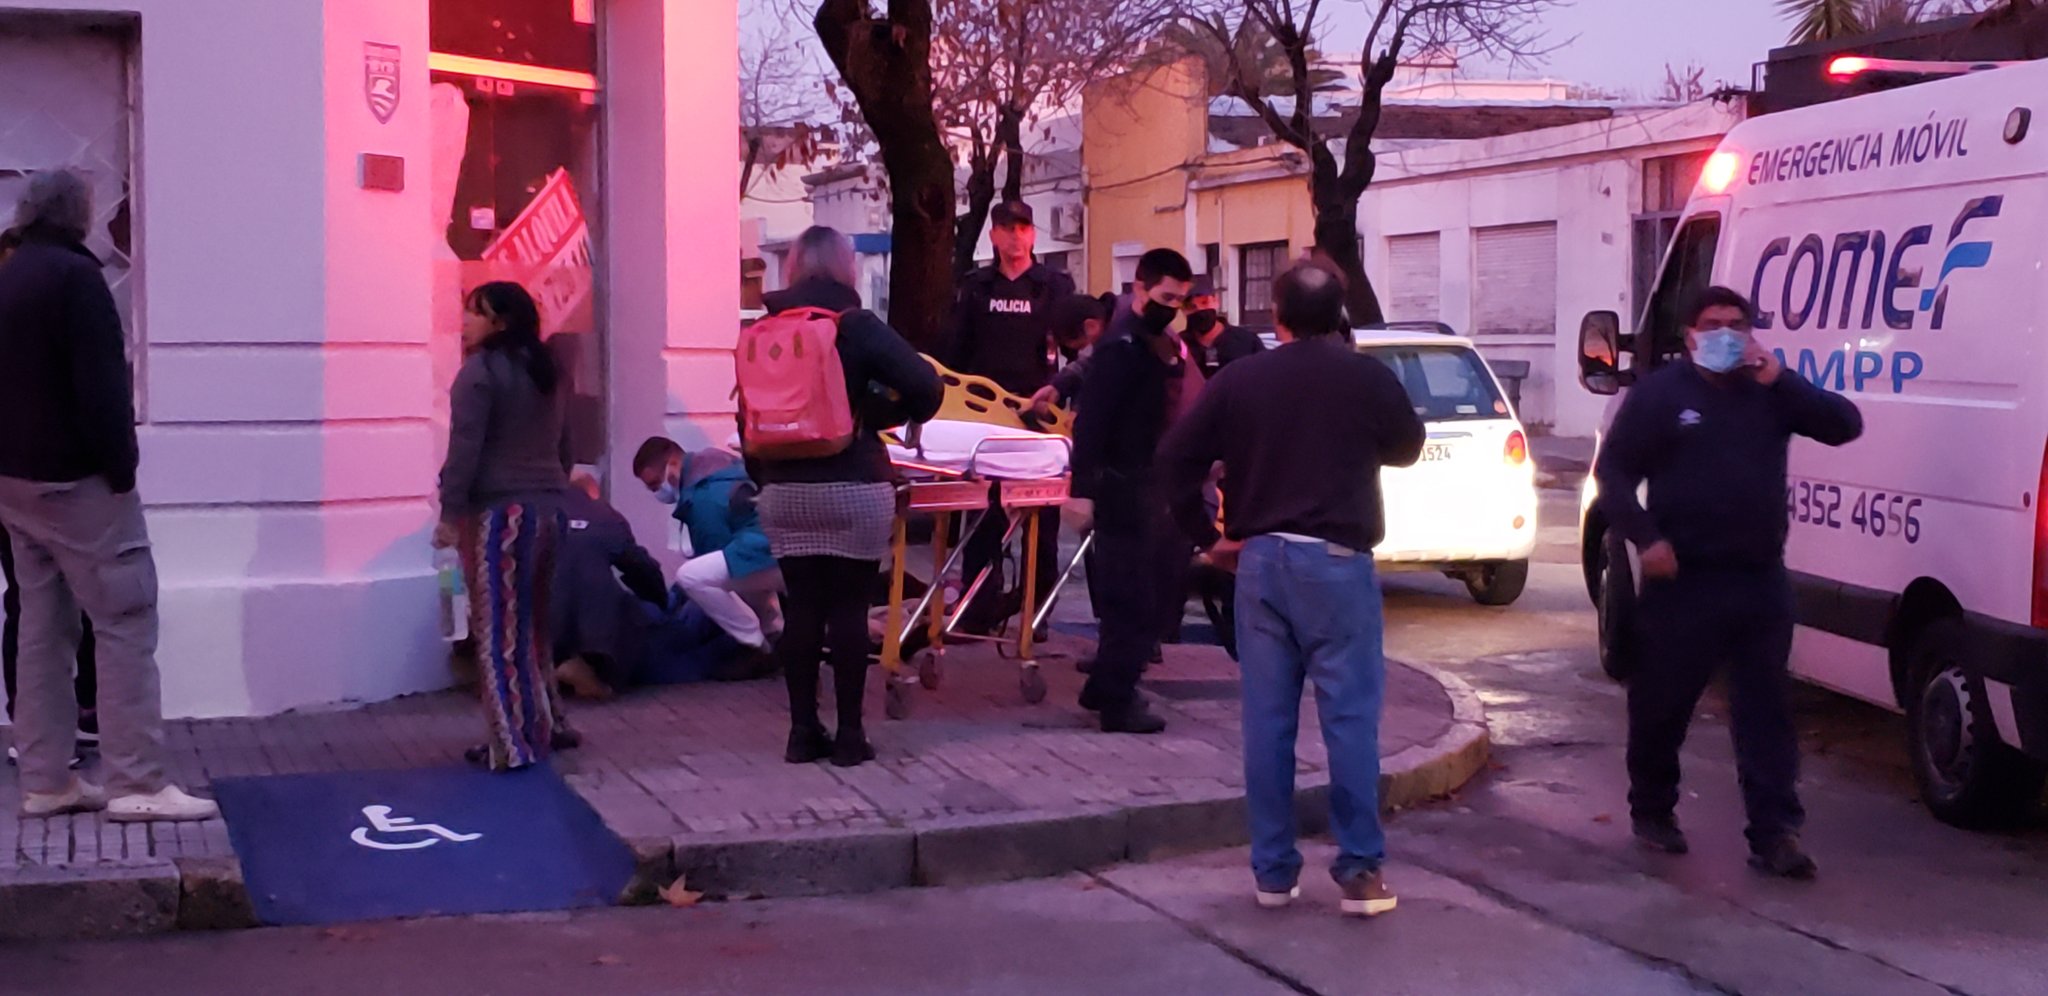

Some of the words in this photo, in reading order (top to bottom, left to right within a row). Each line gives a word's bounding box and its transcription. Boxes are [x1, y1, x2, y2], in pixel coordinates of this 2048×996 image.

[1747, 132, 1883, 185] EMERGENCIA
[1890, 110, 1968, 168] MÓVIL
[989, 298, 1032, 314] POLICIA
[1420, 446, 1451, 462] 1524
[1786, 481, 1842, 529] 4352
[1851, 491, 1922, 544] 4656
